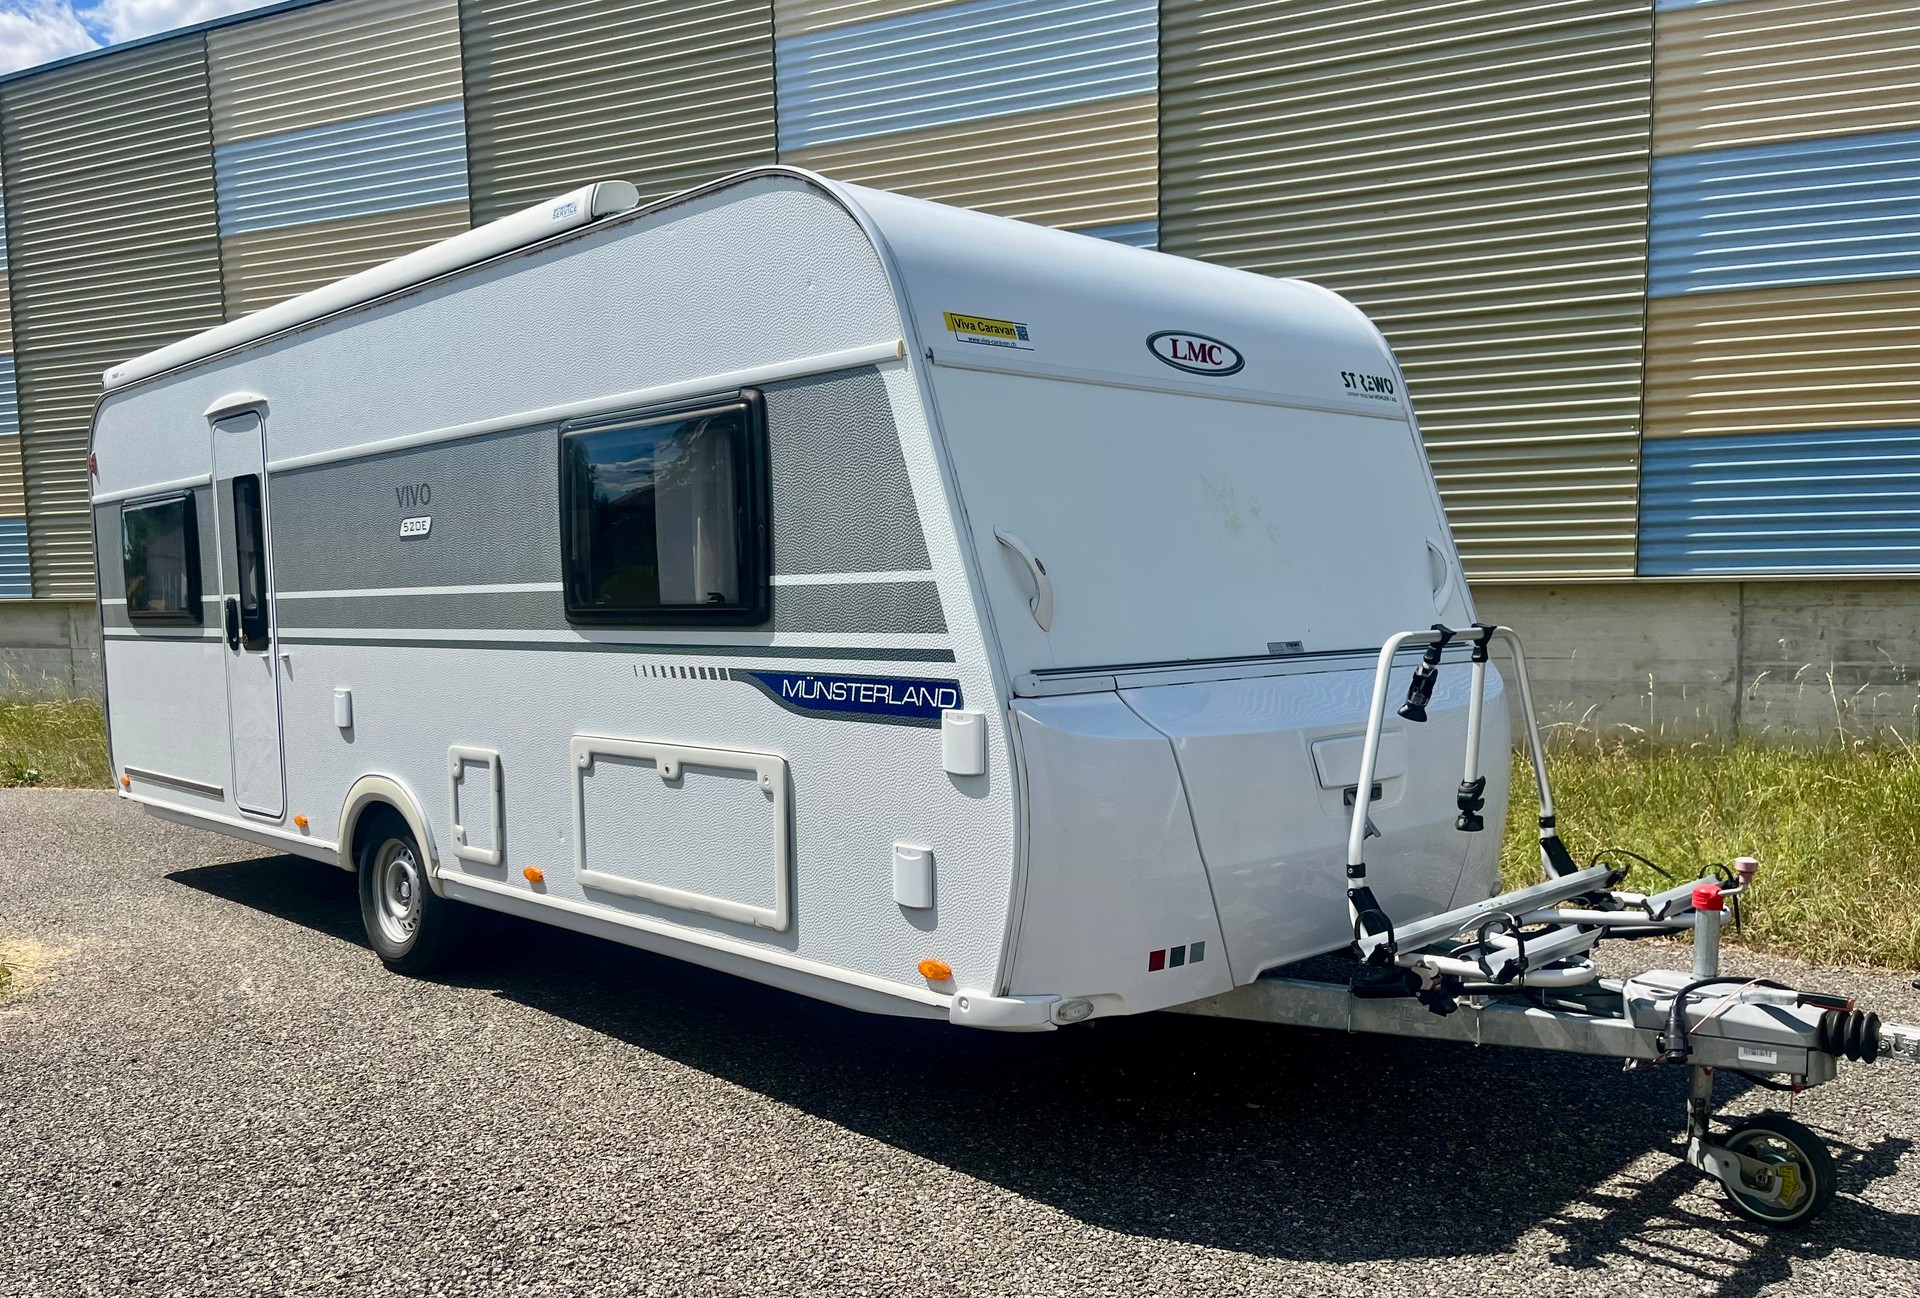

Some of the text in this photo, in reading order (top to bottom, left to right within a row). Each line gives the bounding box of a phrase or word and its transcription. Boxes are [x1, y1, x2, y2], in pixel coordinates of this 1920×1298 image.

[552, 204, 577, 219] SERVICE
[954, 318, 1016, 336] Viva Caravan
[1170, 338, 1223, 365] LMC
[396, 483, 431, 508] VIVO
[403, 520, 427, 532] 520E
[782, 676, 957, 708] MÜNSTERLAND
